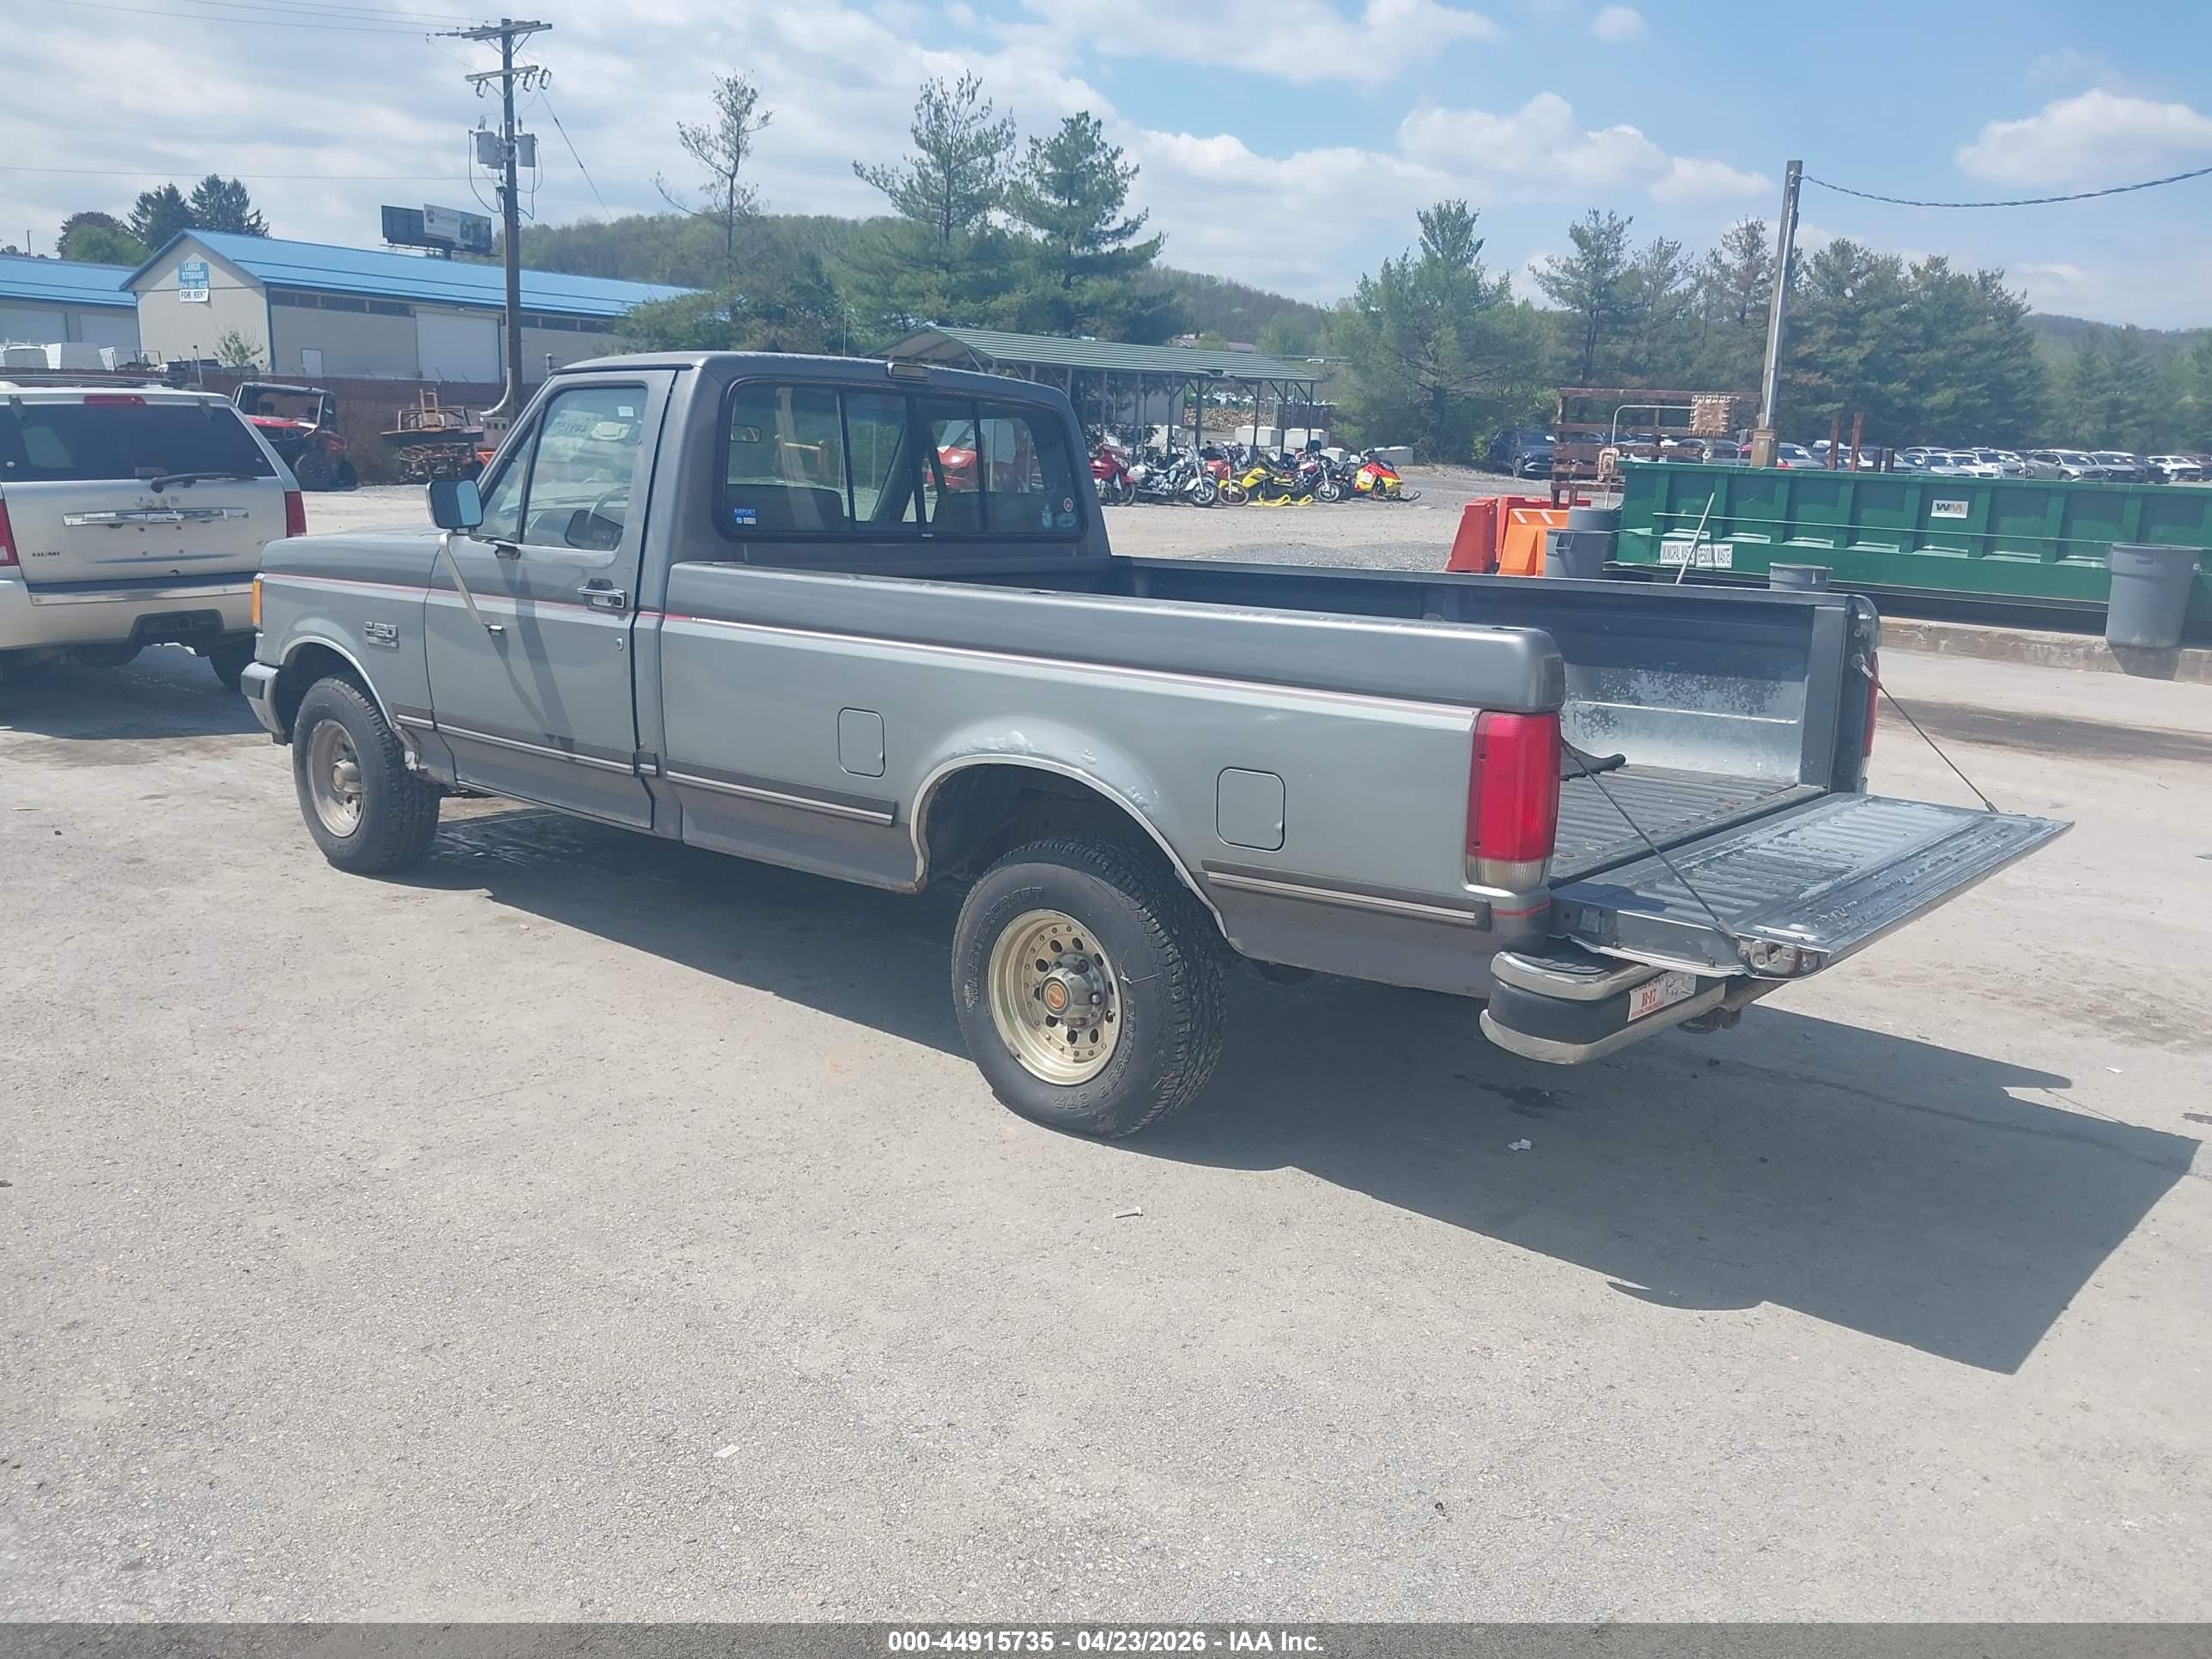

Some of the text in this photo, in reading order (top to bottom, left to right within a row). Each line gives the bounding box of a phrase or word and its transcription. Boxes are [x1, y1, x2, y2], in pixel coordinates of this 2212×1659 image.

[181, 271, 205, 280] STORAGE
[180, 290, 207, 299] FOR RENT
[1936, 502, 1964, 513] WM
[1662, 544, 1680, 561] MUNICIPAL
[1698, 547, 1731, 564] RESIDUAL WASTE
[1053, 1091, 1091, 1109] STR
